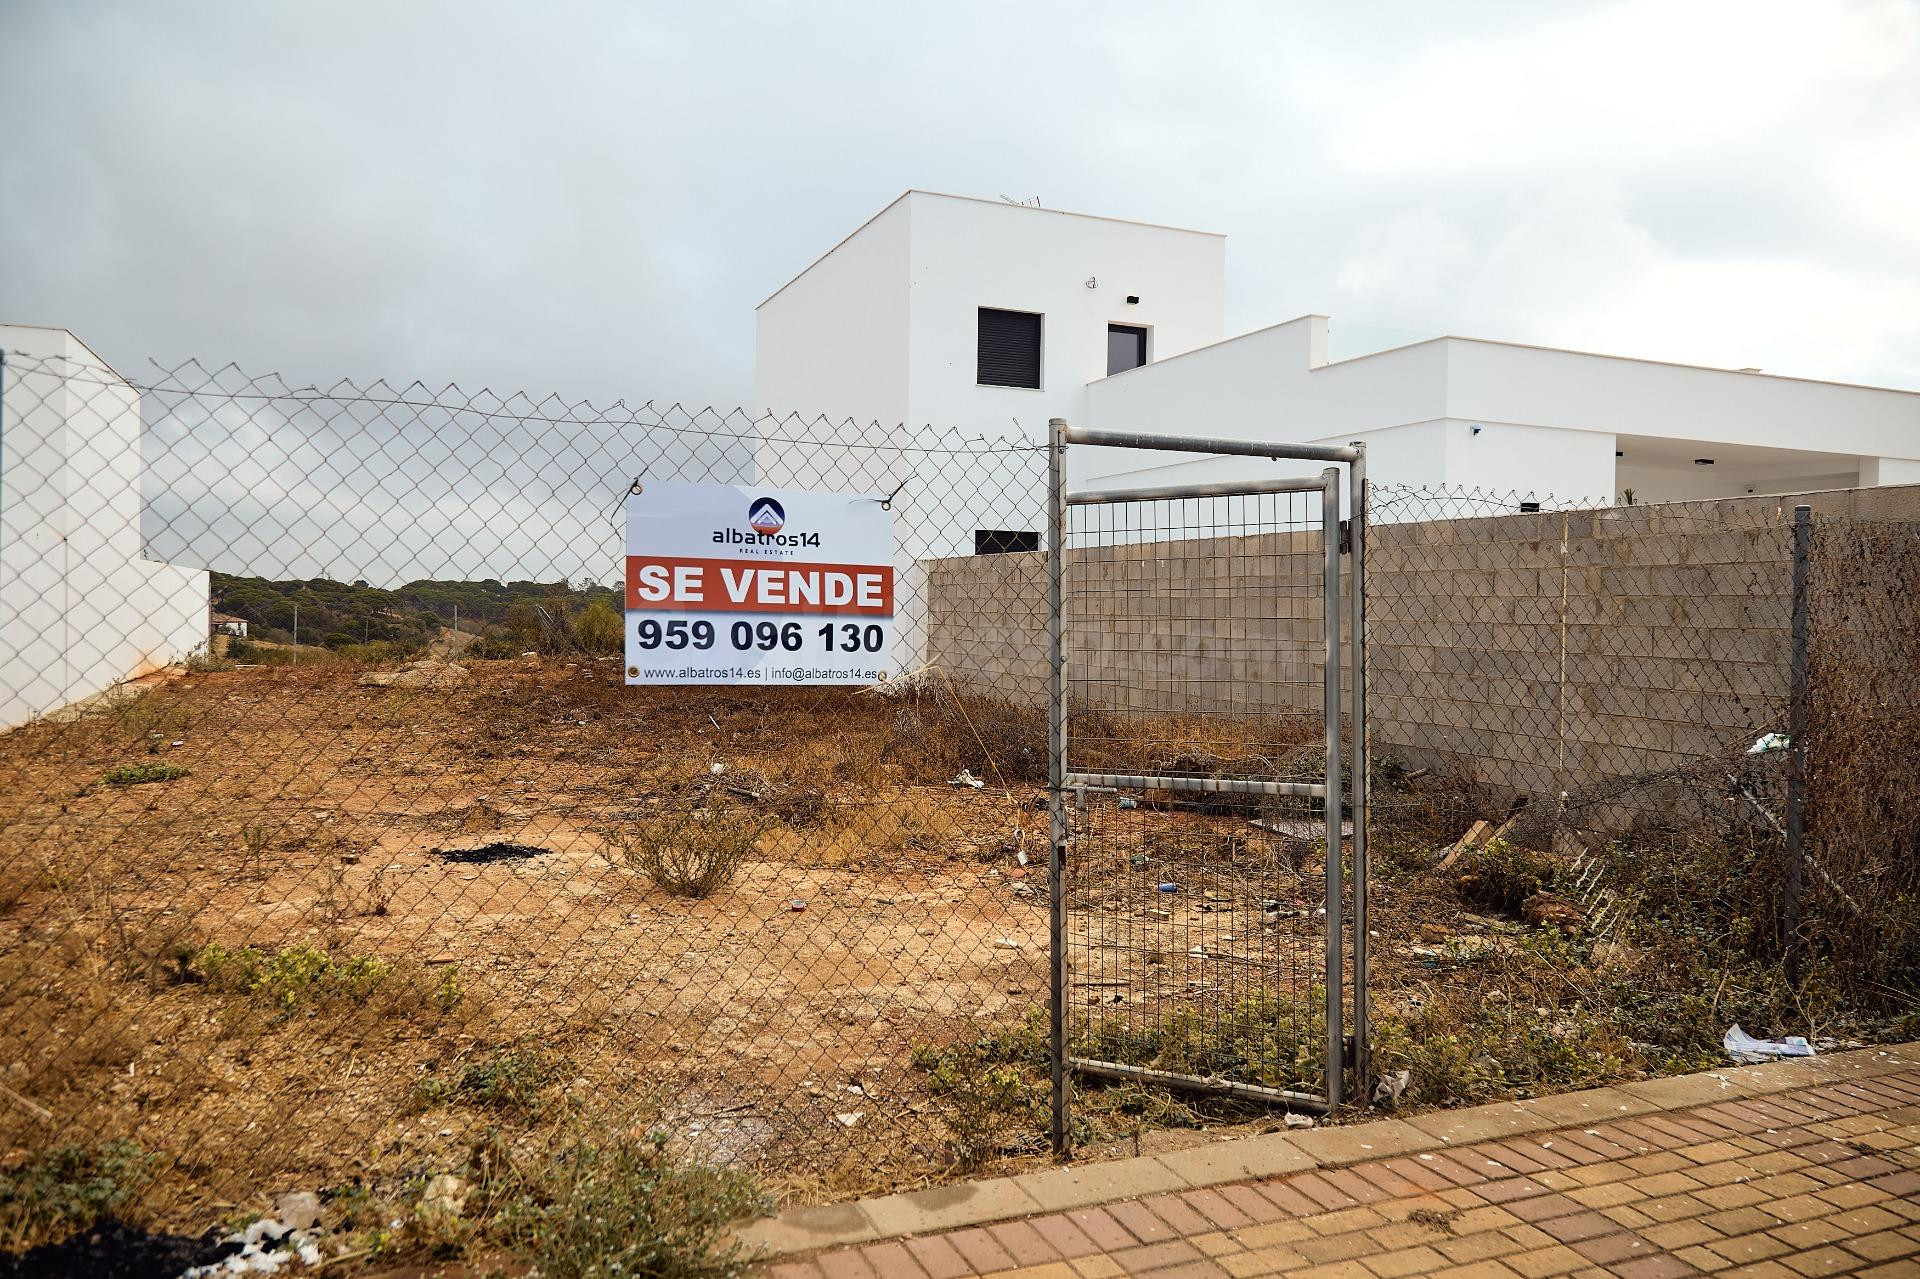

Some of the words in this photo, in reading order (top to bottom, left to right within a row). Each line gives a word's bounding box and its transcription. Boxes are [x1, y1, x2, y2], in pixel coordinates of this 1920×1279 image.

[712, 527, 821, 548] albatros14
[638, 565, 704, 602] SE
[720, 567, 883, 607] VENDE
[637, 619, 715, 650] 959
[730, 621, 803, 652] 096
[818, 622, 884, 652] 130
[644, 667, 761, 679] www.albatros14.es
[771, 667, 877, 681] info@albatros14.es
